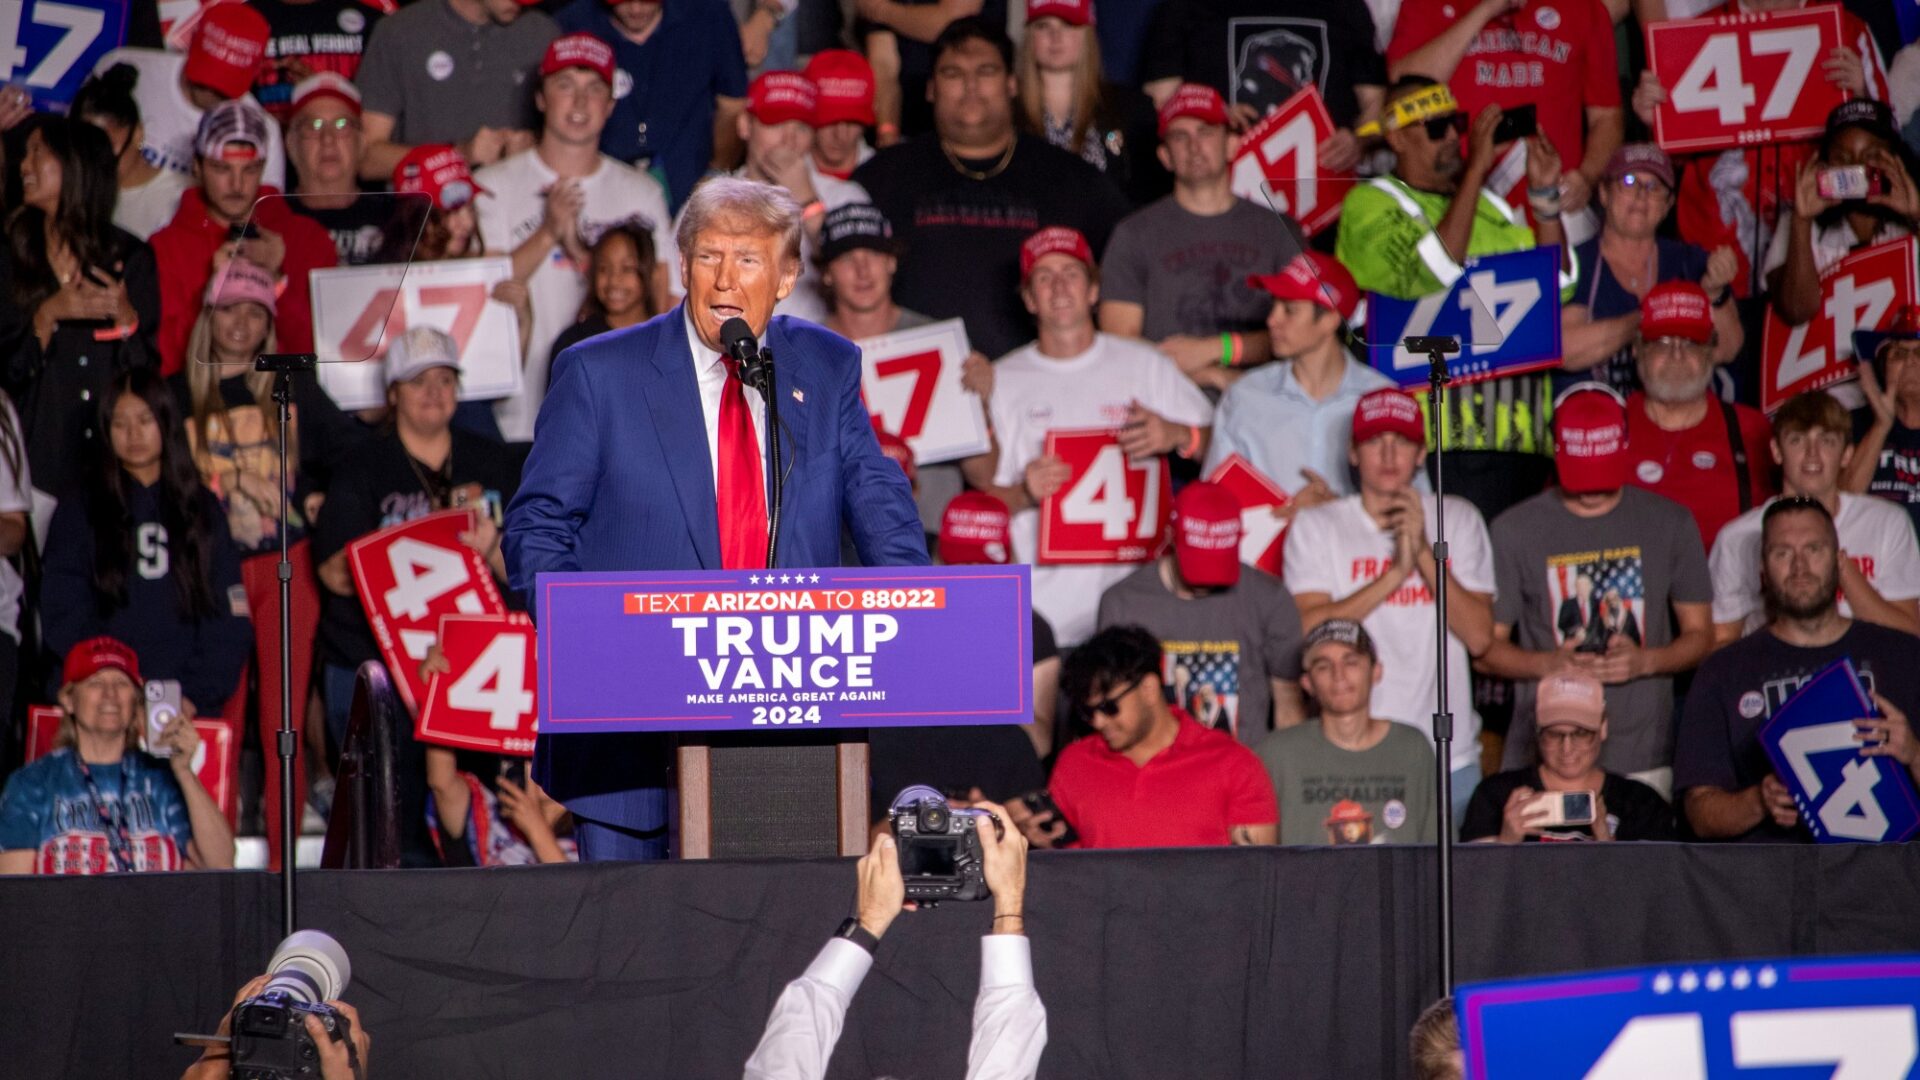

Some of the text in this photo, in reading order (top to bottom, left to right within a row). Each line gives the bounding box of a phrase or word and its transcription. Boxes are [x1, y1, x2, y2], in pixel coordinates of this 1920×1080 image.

[1475, 60, 1544, 87] MADE
[1671, 24, 1821, 125] 47
[340, 284, 487, 363] 47
[860, 349, 942, 440] 7
[1060, 444, 1161, 540] 47
[137, 521, 169, 580] S
[634, 589, 936, 613] TEXT ARIZONA TO 88022
[672, 614, 899, 657] TRUMP
[446, 632, 539, 731] 4
[687, 690, 886, 704] MAKE AMERICA GREAT AGAIN!
[698, 655, 874, 691] VANCE
[752, 705, 822, 725] 2024
